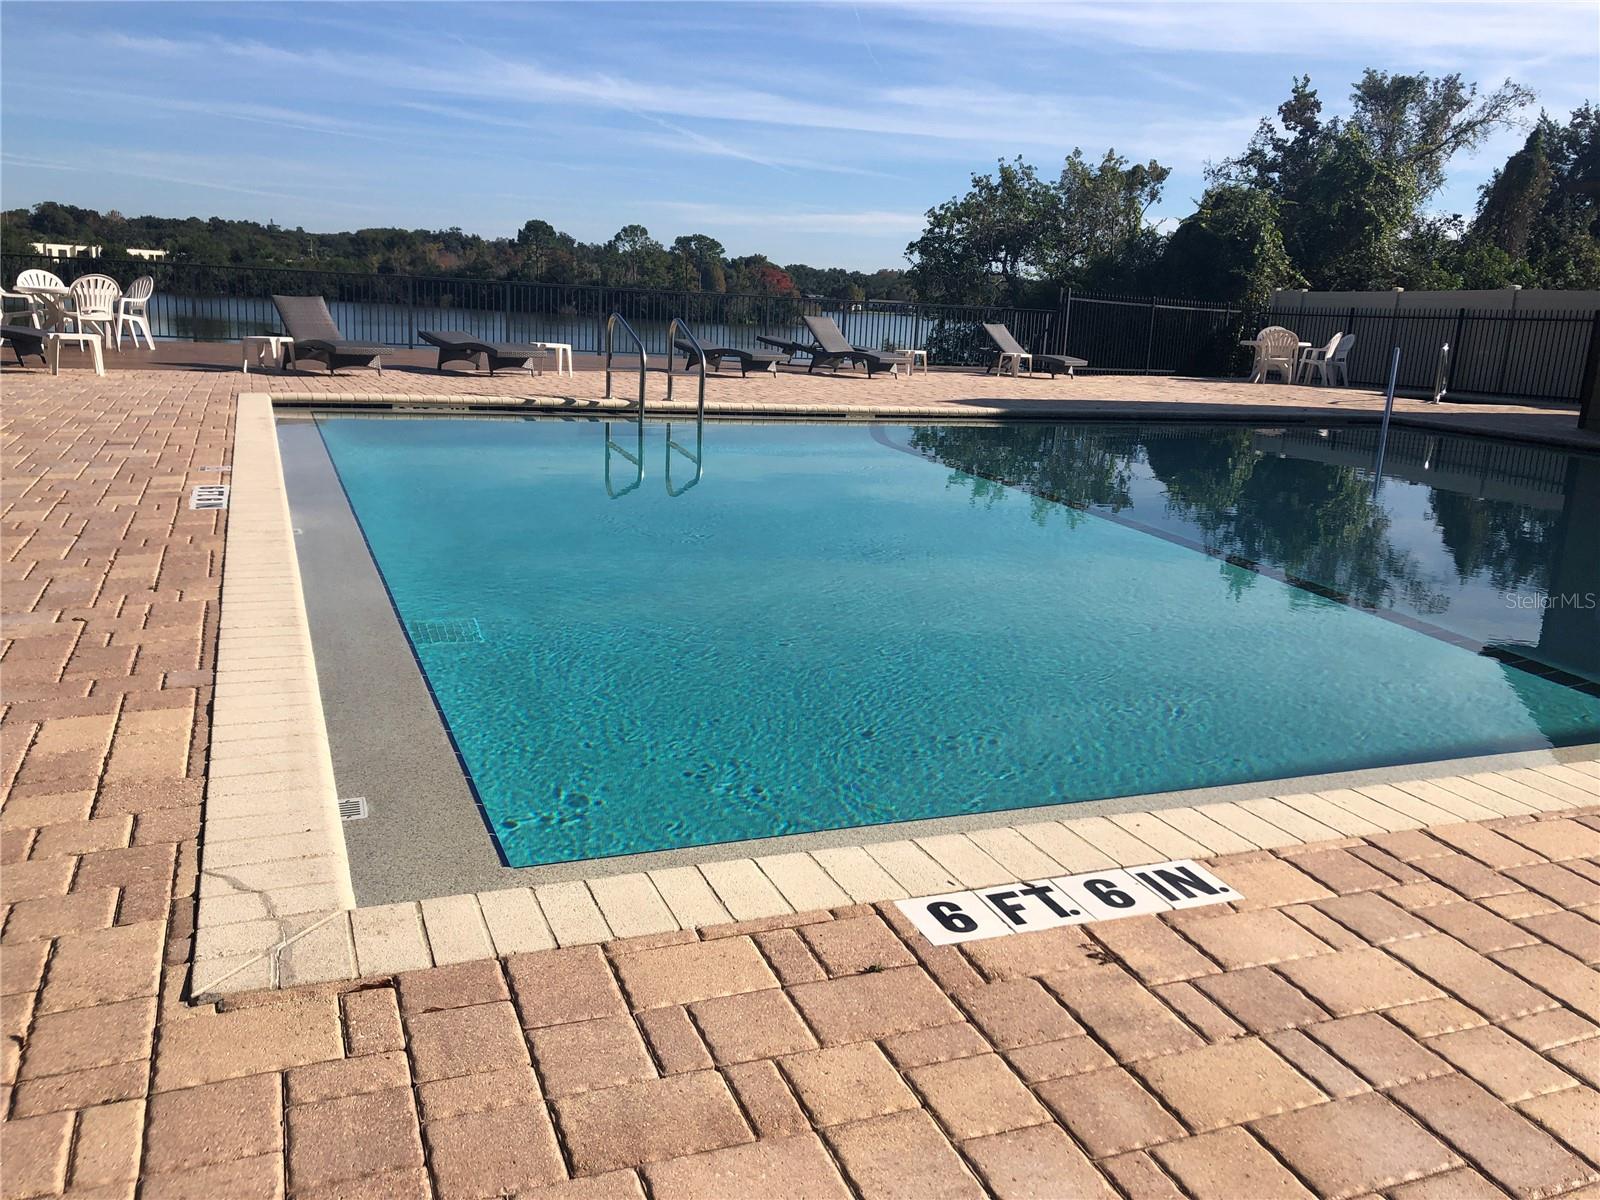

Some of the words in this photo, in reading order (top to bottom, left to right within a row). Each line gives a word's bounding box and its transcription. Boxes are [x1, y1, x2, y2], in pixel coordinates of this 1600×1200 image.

[926, 901, 978, 933] 6
[985, 885, 1081, 926] FT.
[1083, 878, 1136, 909] 6
[1134, 865, 1230, 901] IN.
